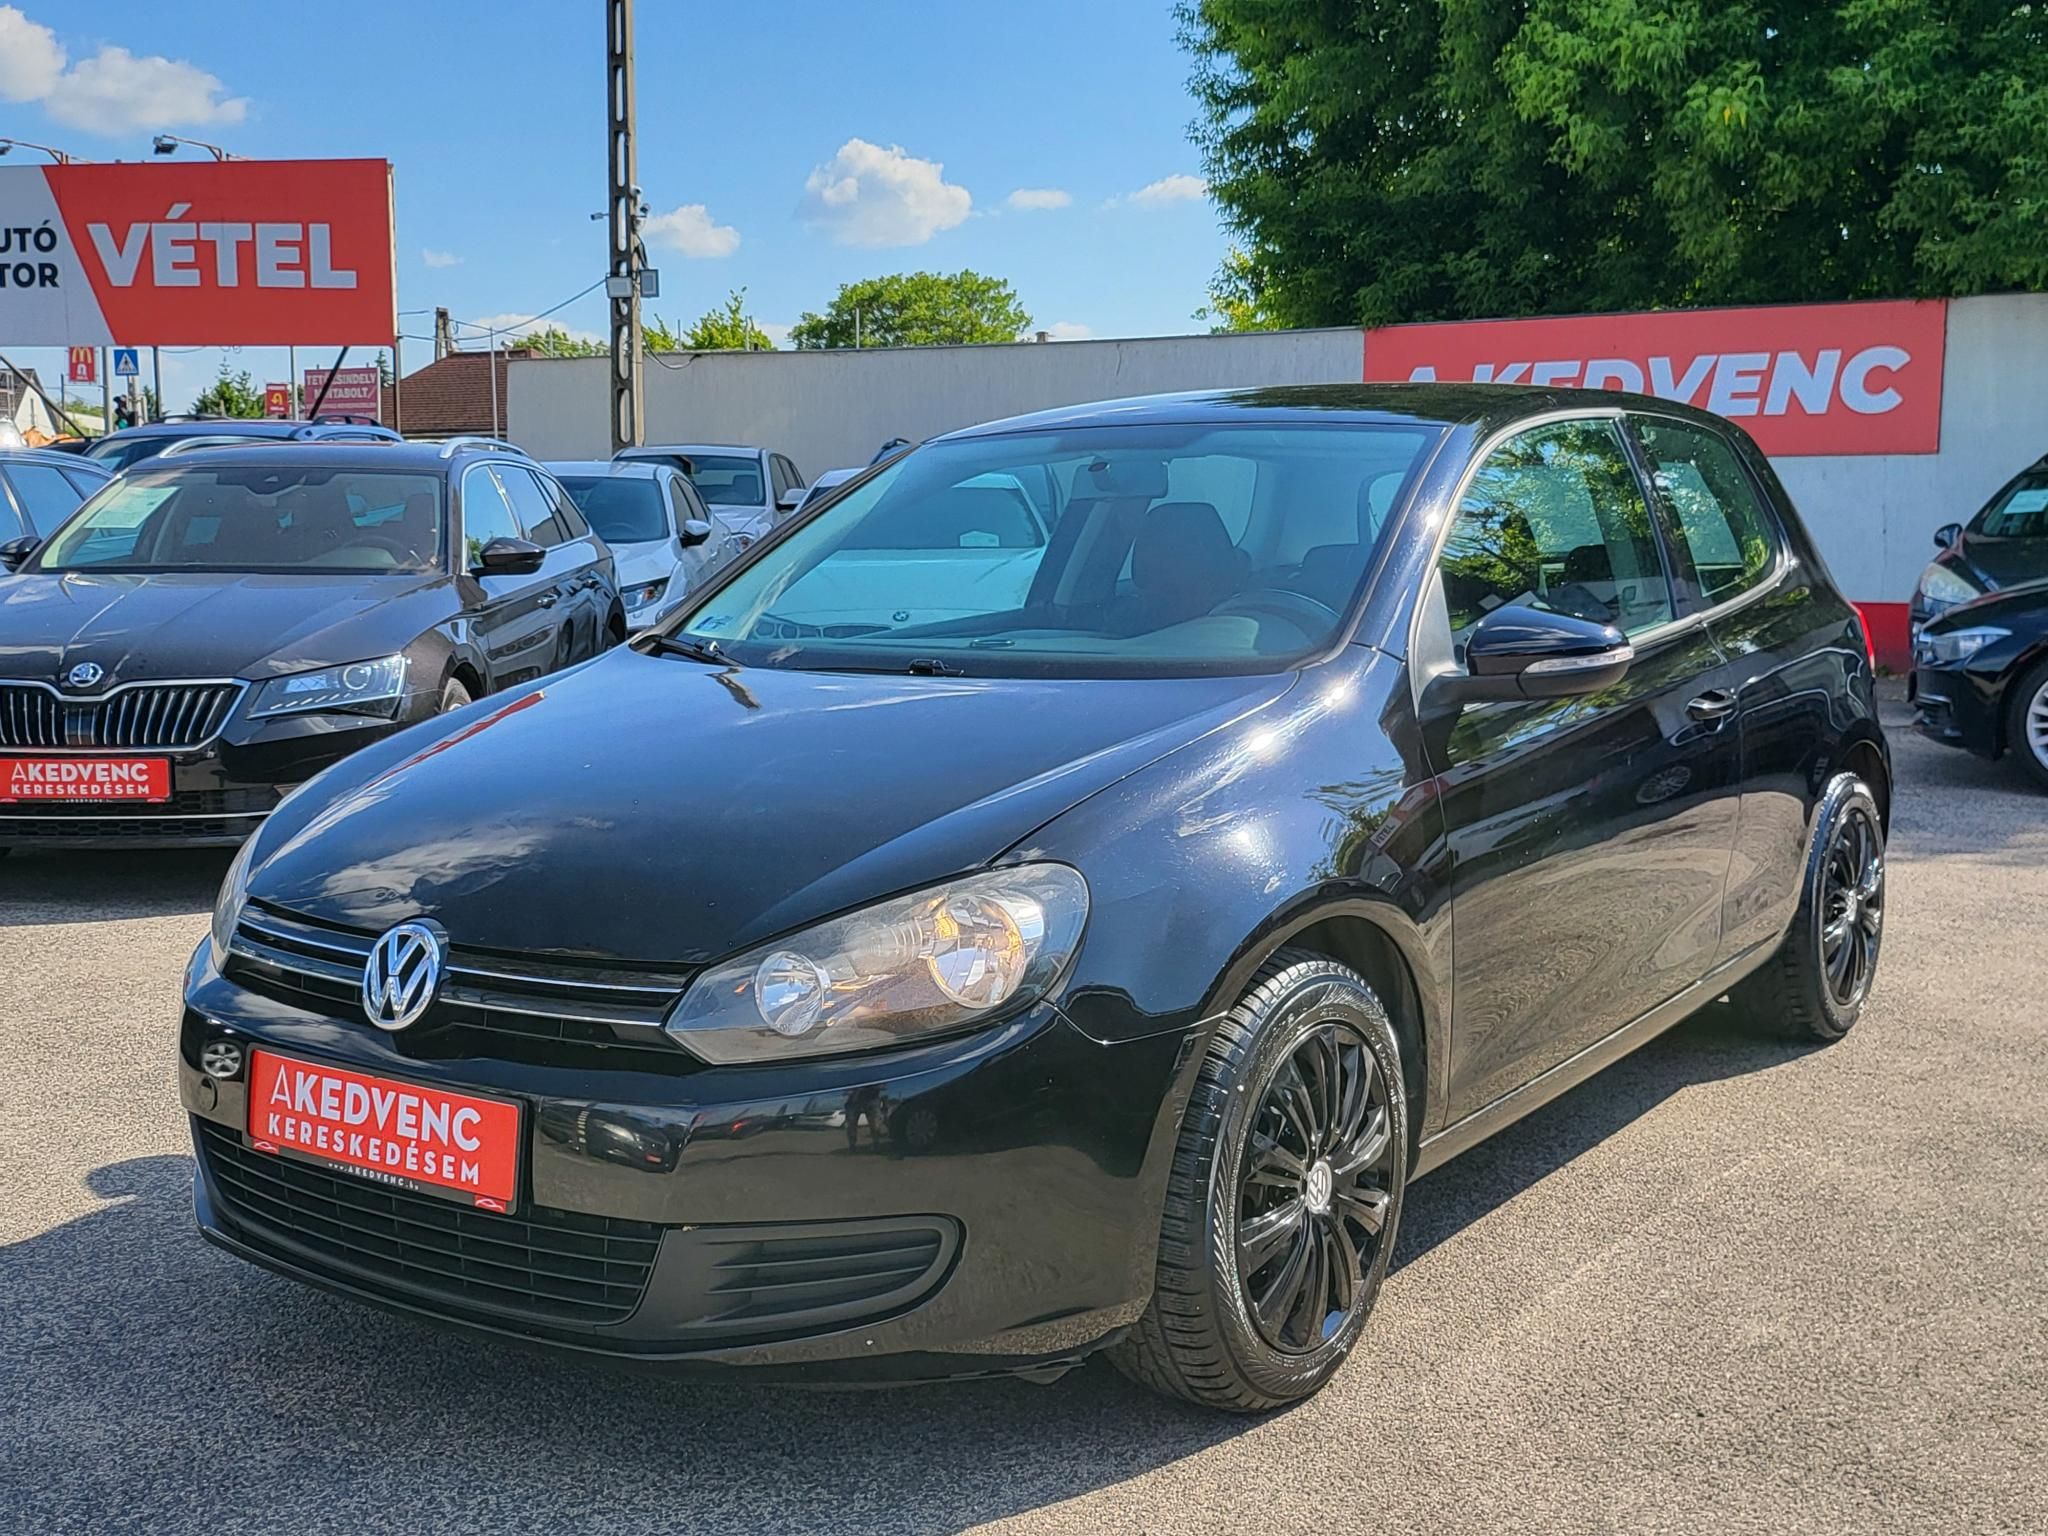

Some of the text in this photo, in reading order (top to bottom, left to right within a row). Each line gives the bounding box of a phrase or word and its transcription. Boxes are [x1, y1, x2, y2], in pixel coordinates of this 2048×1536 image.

[86, 203, 358, 289] VÉTEL
[11, 782, 149, 795] KERESKEDÉSEM
[268, 1112, 480, 1186] KERESKEDÉSEM
